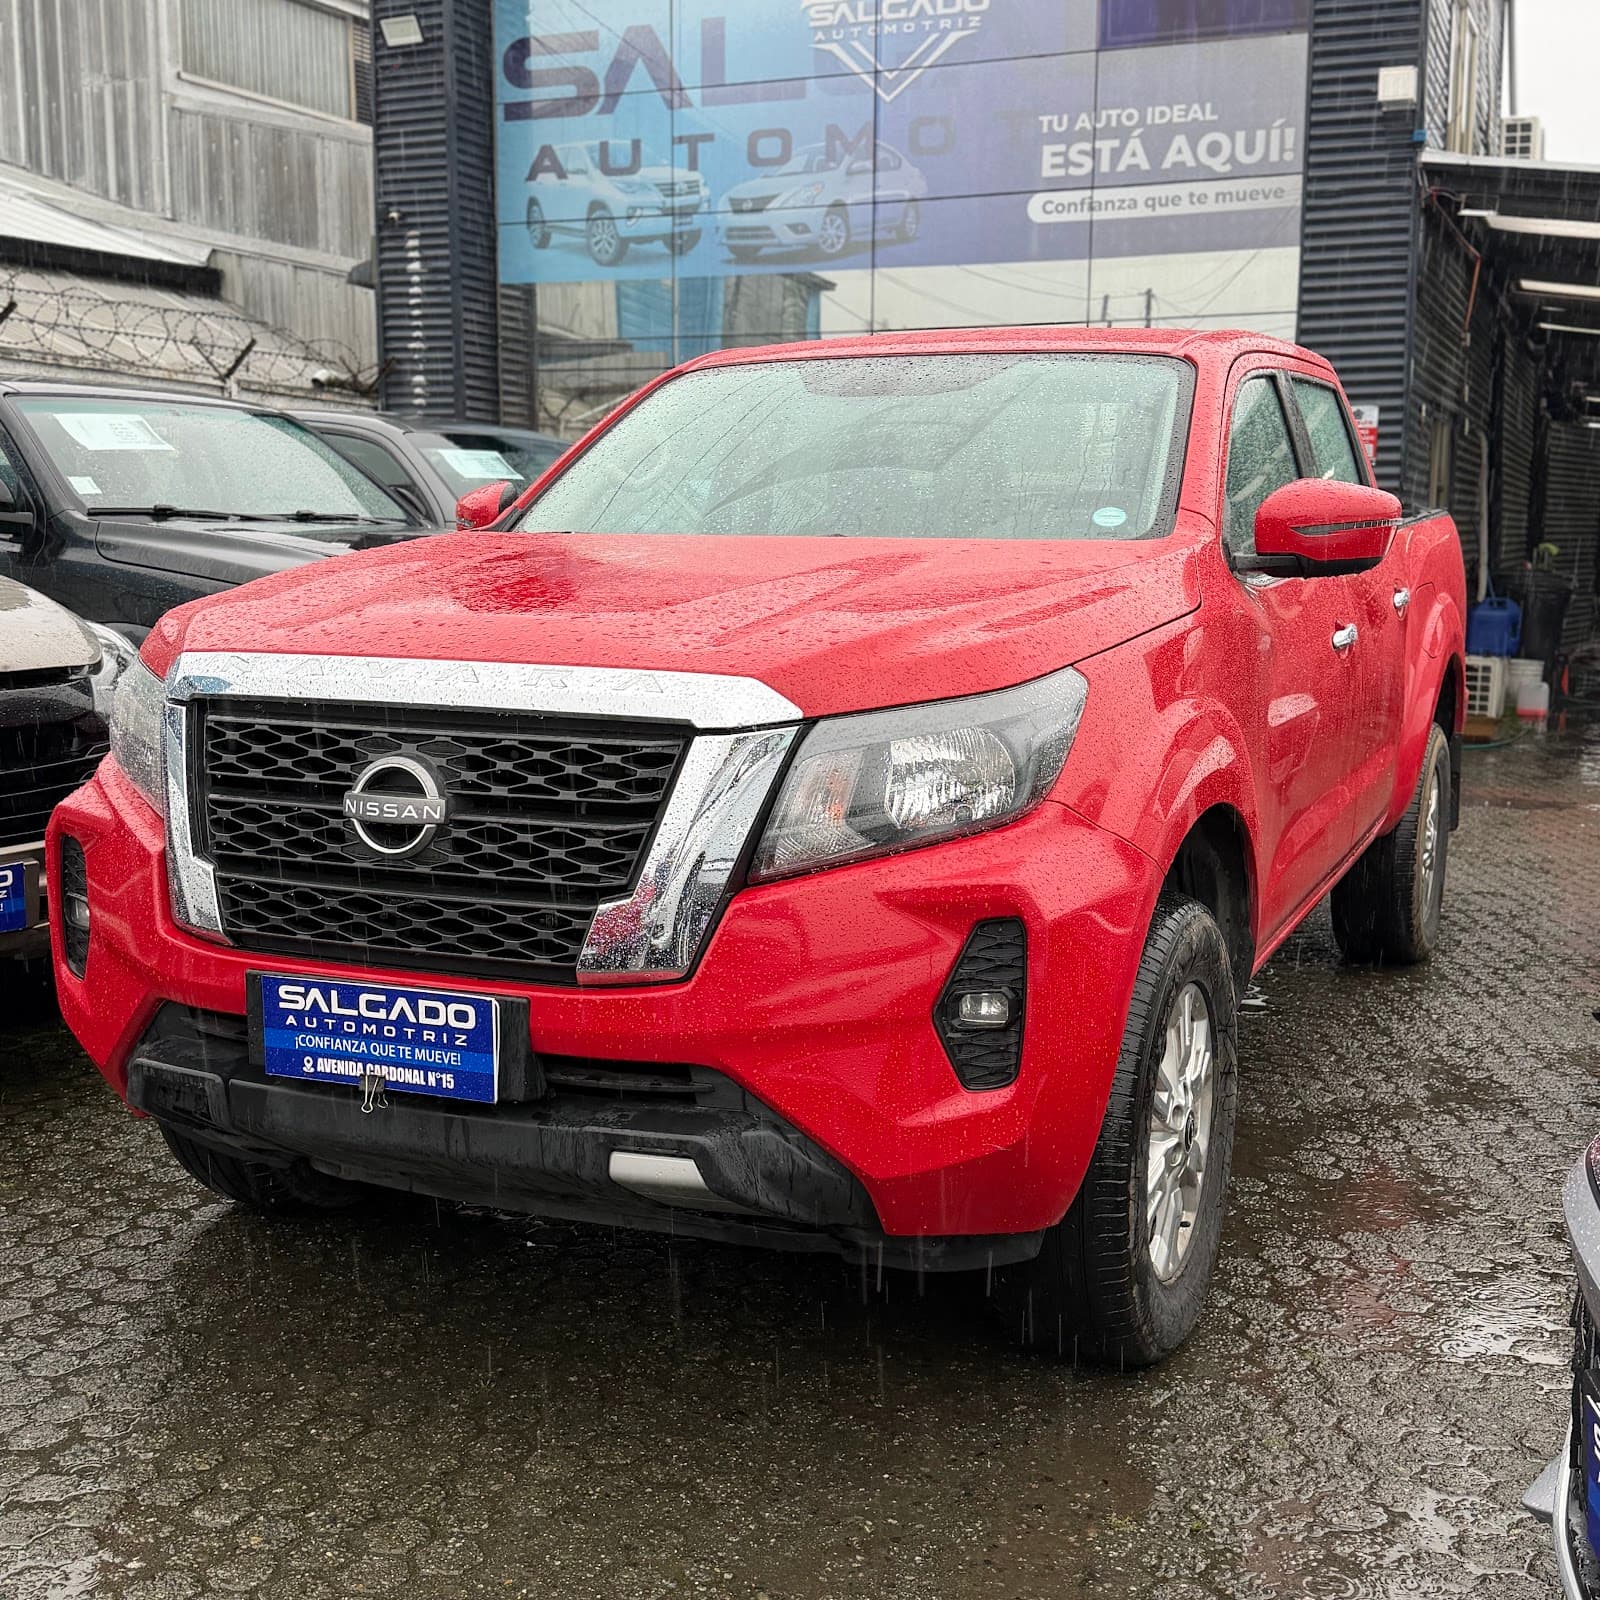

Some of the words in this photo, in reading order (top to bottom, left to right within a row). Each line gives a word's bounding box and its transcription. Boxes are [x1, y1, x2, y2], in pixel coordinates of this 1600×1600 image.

[814, 16, 982, 41] AUTOMOTRIZ
[1039, 114, 1068, 133] TU
[1075, 108, 1139, 131] AUTO
[1146, 102, 1219, 125] IDEAL
[1041, 128, 1151, 178] ESTÁ
[1161, 118, 1296, 173] AQUÍ!
[1042, 197, 1138, 215] Confianza
[1144, 194, 1182, 211] que
[1188, 191, 1209, 206] te
[1214, 187, 1286, 203] mueve
[345, 798, 441, 820] NISSAN
[279, 985, 476, 1030] SALGADO
[286, 1015, 468, 1046] AUTOMOTRIZ
[295, 1034, 367, 1054] ¡CONFIANZA
[370, 1043, 395, 1057] QUE
[397, 1045, 412, 1059] TE
[415, 1047, 461, 1066] MUEVE!
[317, 1058, 364, 1077] AVENIDA
[366, 1063, 426, 1086] CARDONAL
